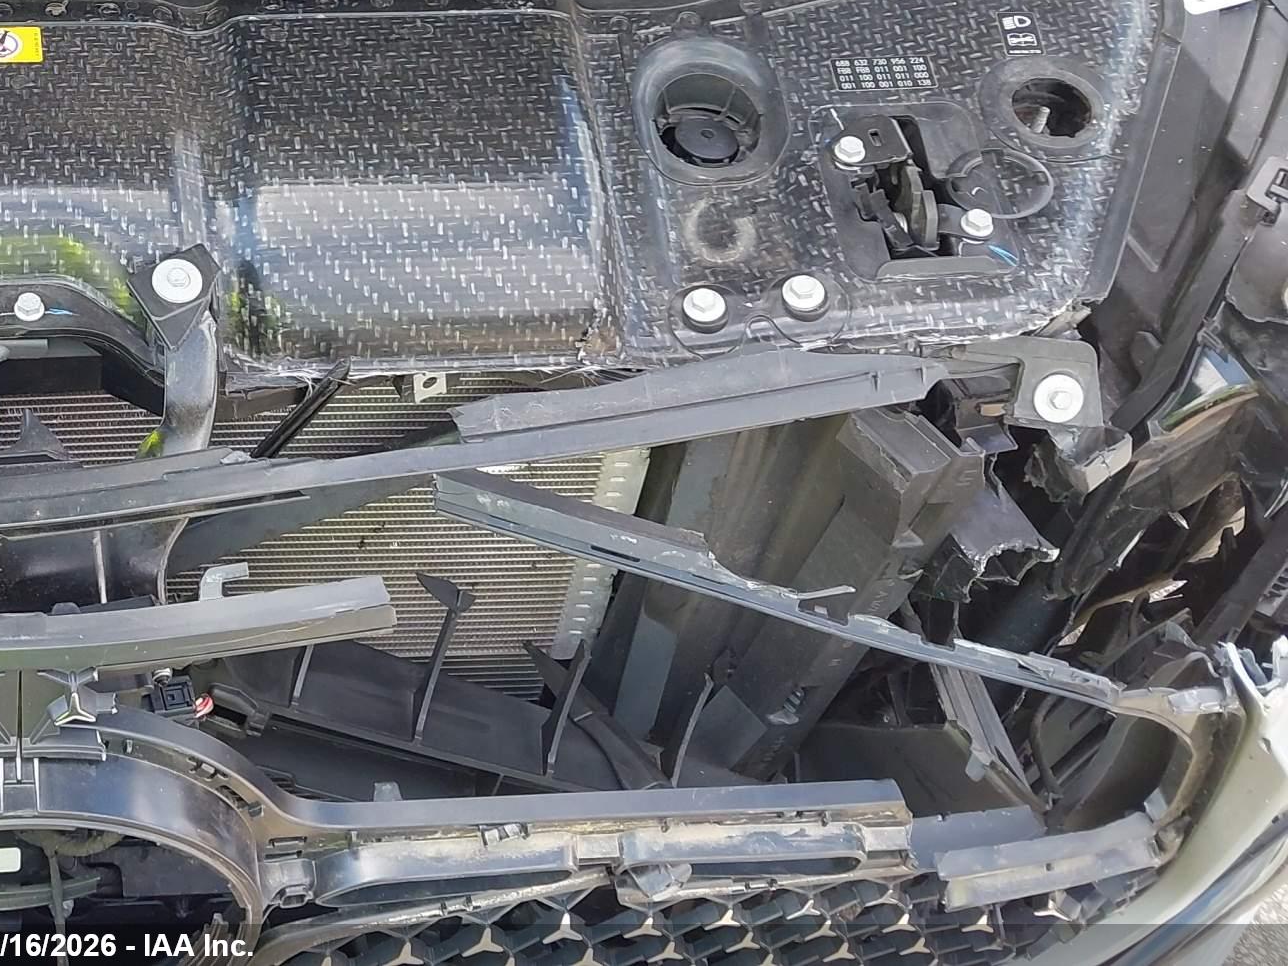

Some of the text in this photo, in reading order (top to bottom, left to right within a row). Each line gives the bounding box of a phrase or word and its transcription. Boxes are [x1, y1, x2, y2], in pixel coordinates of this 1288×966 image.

[895, 72, 910, 80] 011
[841, 82, 856, 90] 001
[861, 81, 876, 89] 100
